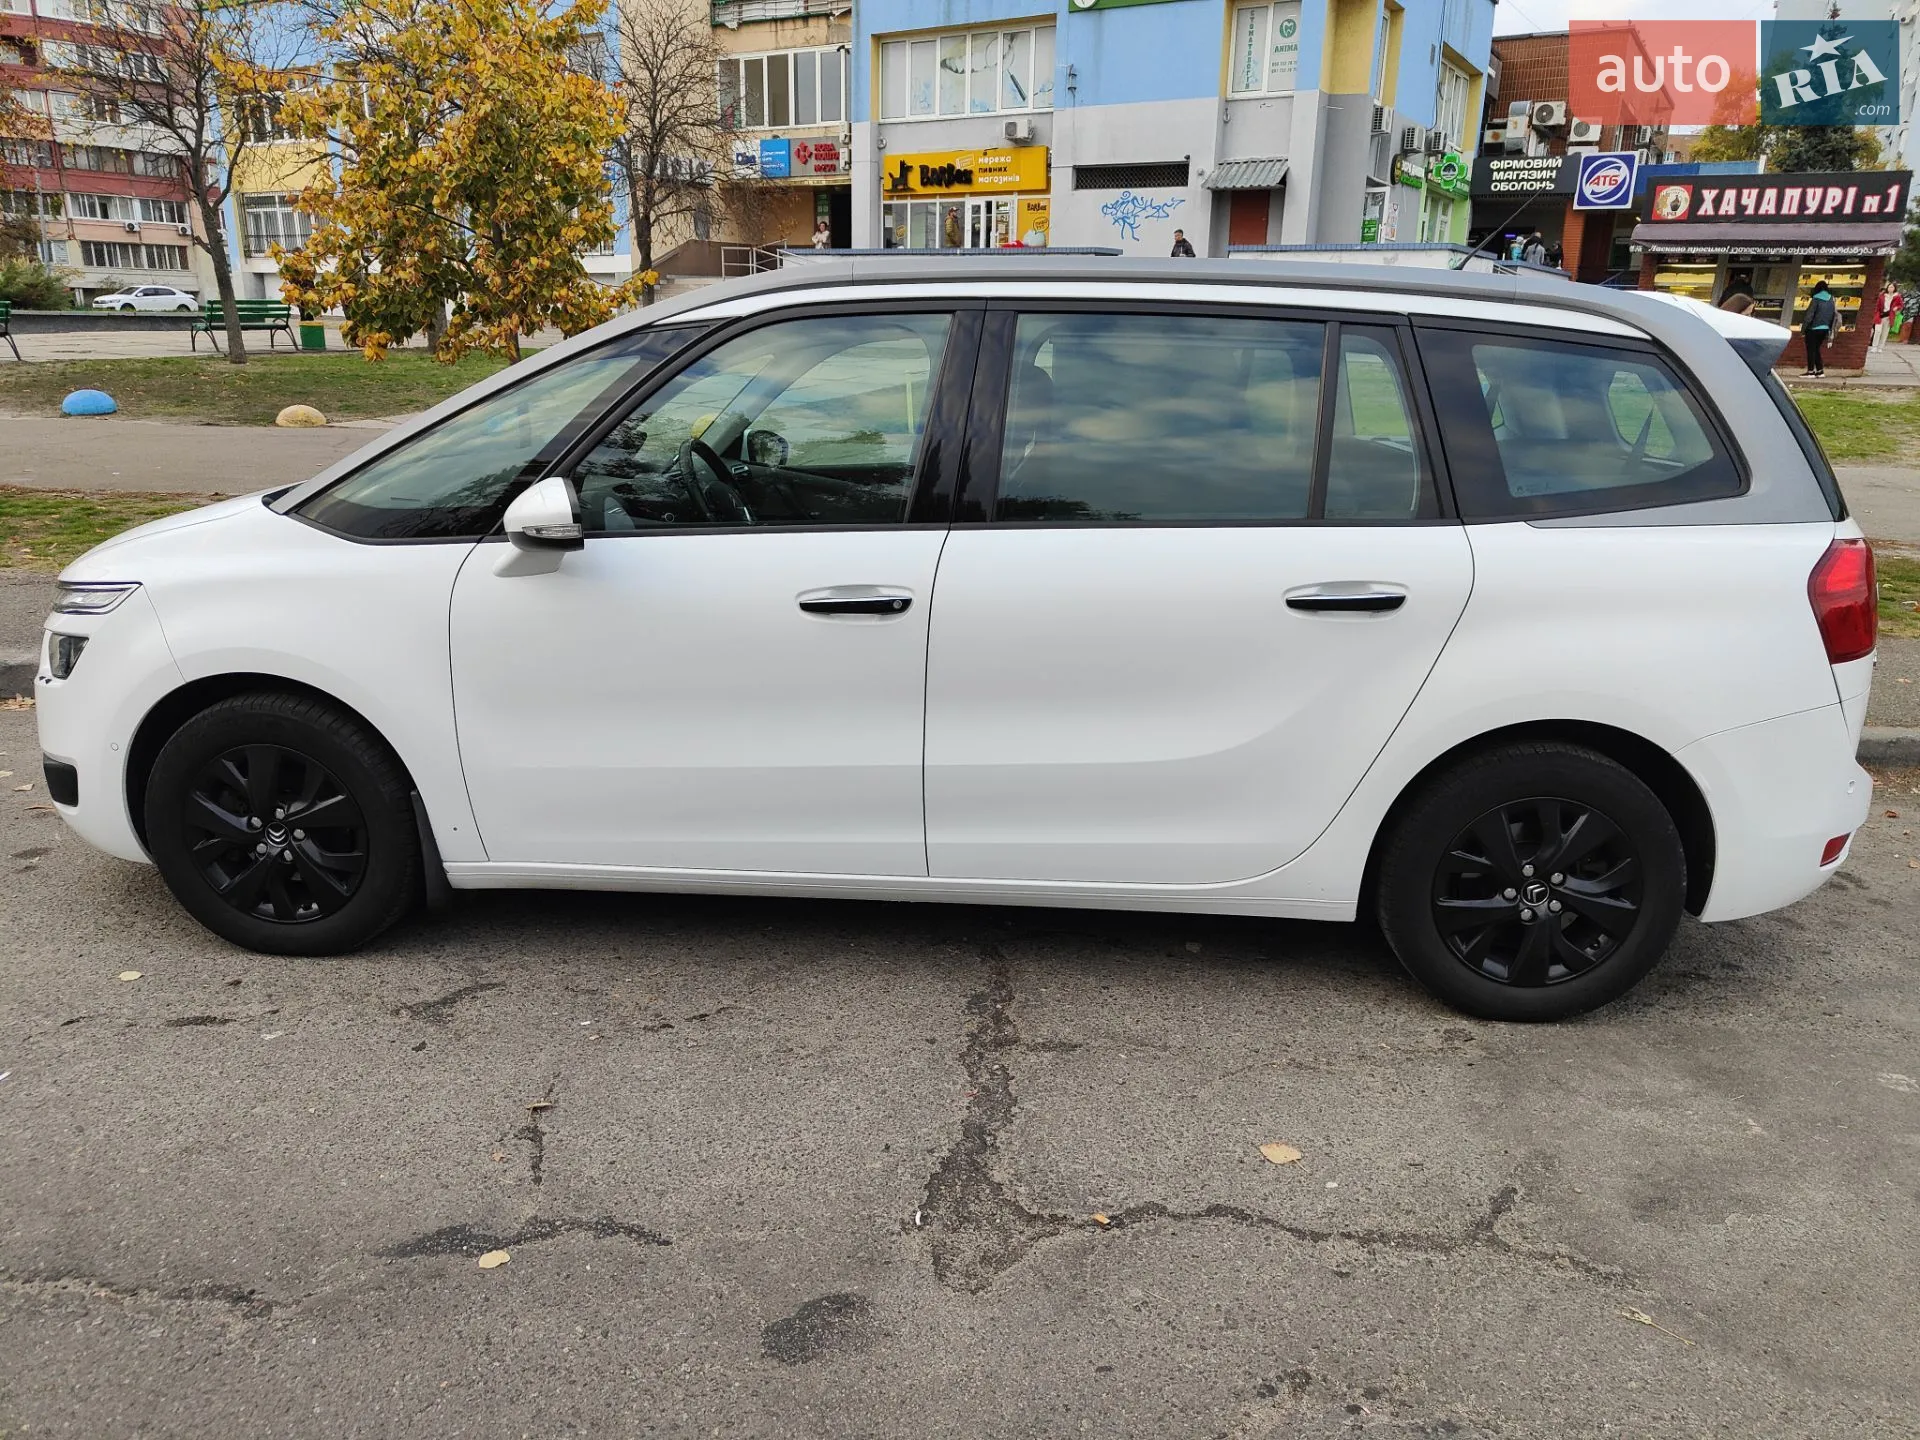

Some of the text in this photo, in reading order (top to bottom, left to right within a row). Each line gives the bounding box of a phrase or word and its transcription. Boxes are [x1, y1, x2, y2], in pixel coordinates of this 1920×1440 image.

[1274, 44, 1298, 53] ANIMA
[978, 155, 1012, 164] мережа
[1489, 157, 1563, 170] ФІРМОВИЙ
[978, 166, 1008, 174] пивних
[978, 175, 1020, 184] магазинів
[1492, 170, 1557, 181] МАГАЗИН
[1589, 175, 1620, 187] АТБ
[1490, 181, 1555, 192] ОБОЛОНЬ
[1697, 186, 1859, 216] ХАЧАПУРІ
[1648, 244, 1686, 252] Ласкаво
[1687, 245, 1730, 254] просимо!
